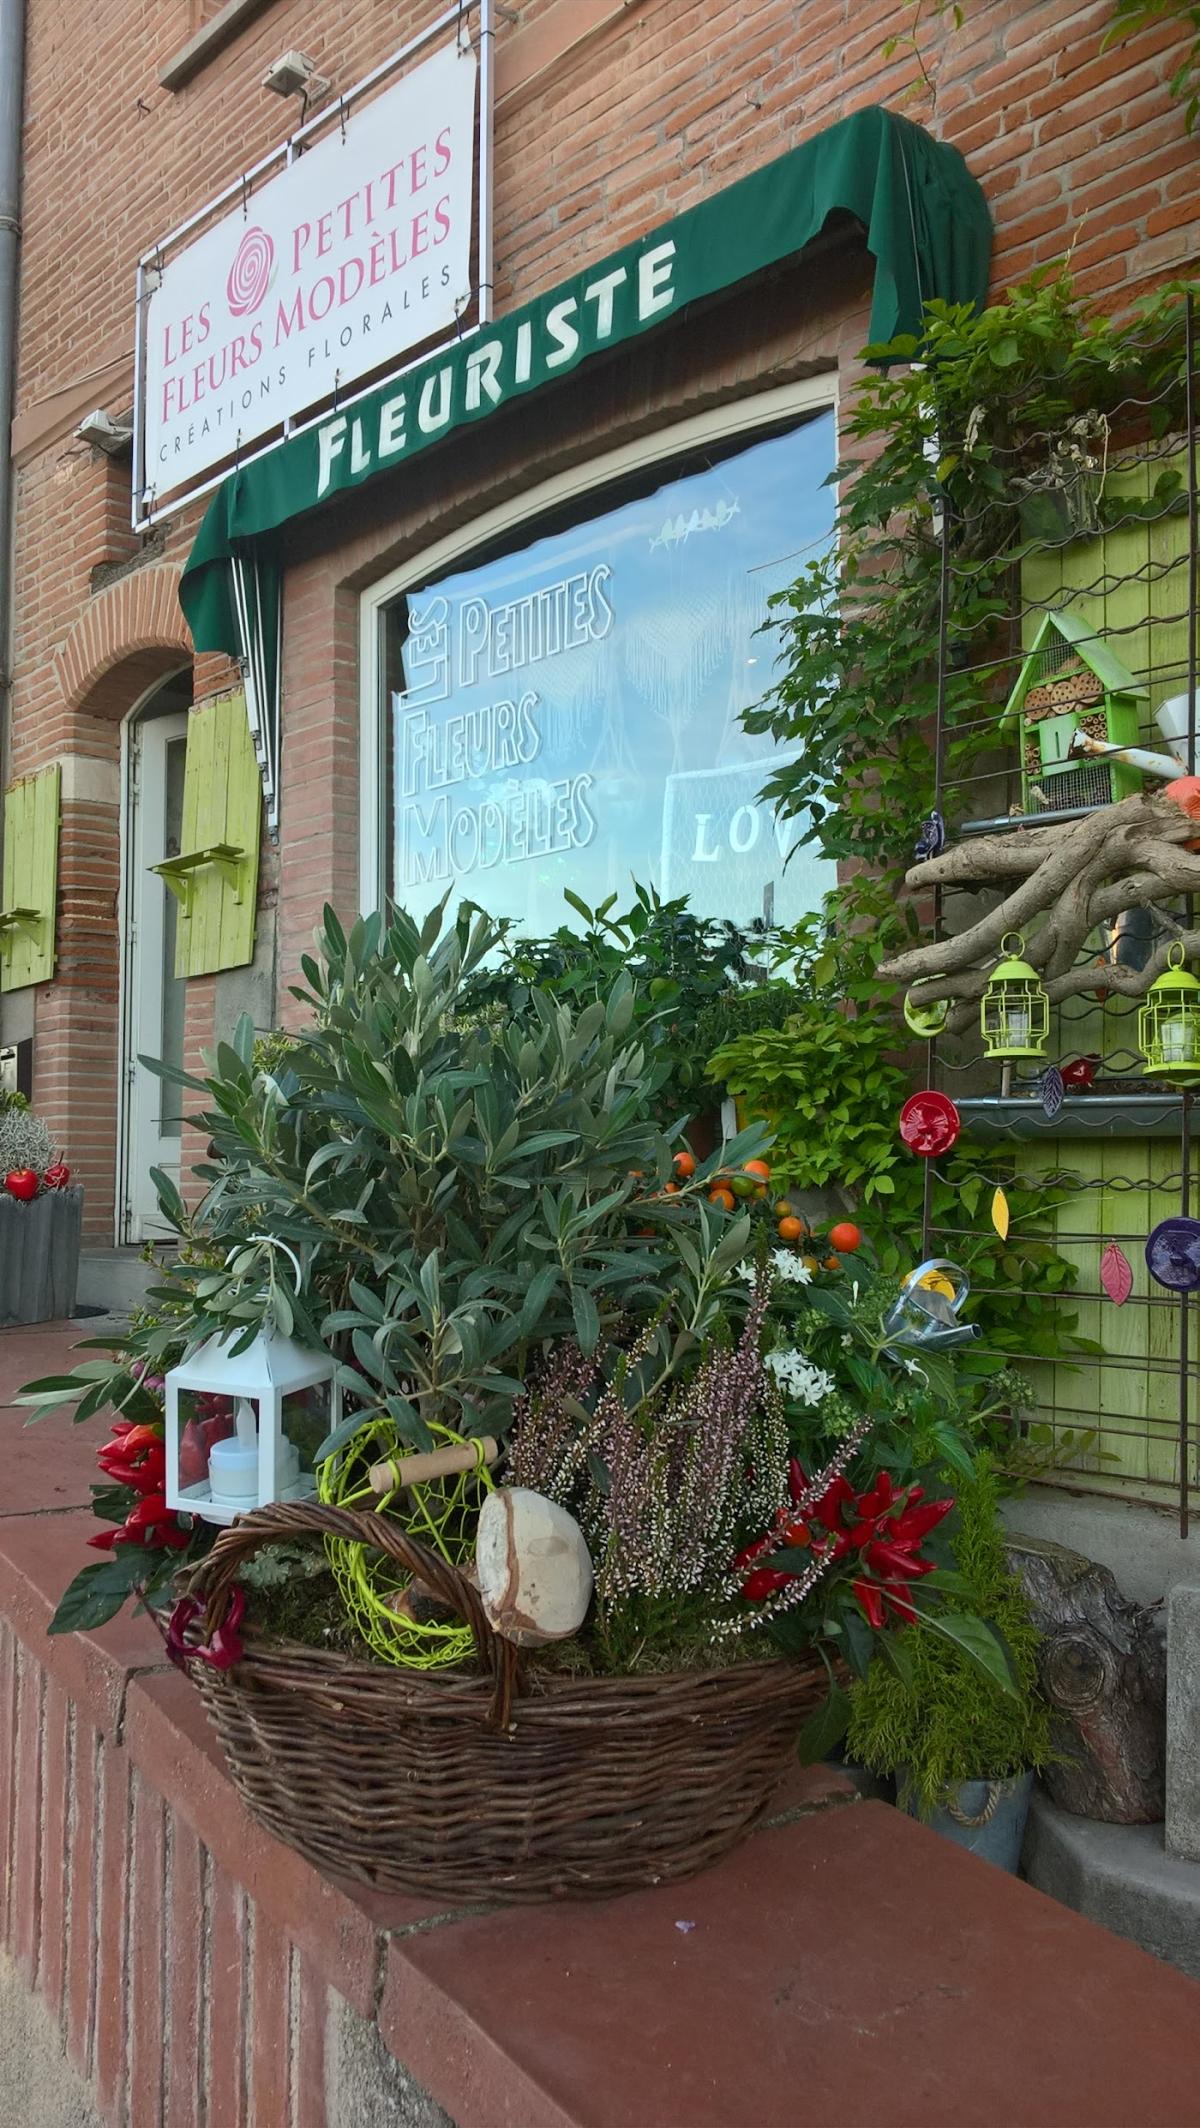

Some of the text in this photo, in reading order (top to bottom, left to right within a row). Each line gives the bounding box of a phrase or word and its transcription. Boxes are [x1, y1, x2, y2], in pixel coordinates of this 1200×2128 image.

[159, 264, 451, 462] CRÉATIONS FLORALES
[162, 194, 453, 426] FLEURS MODÈLES
[163, 126, 453, 369] LES PETITES
[317, 239, 677, 499] FLEURISTE
[691, 804, 798, 862] LOV
